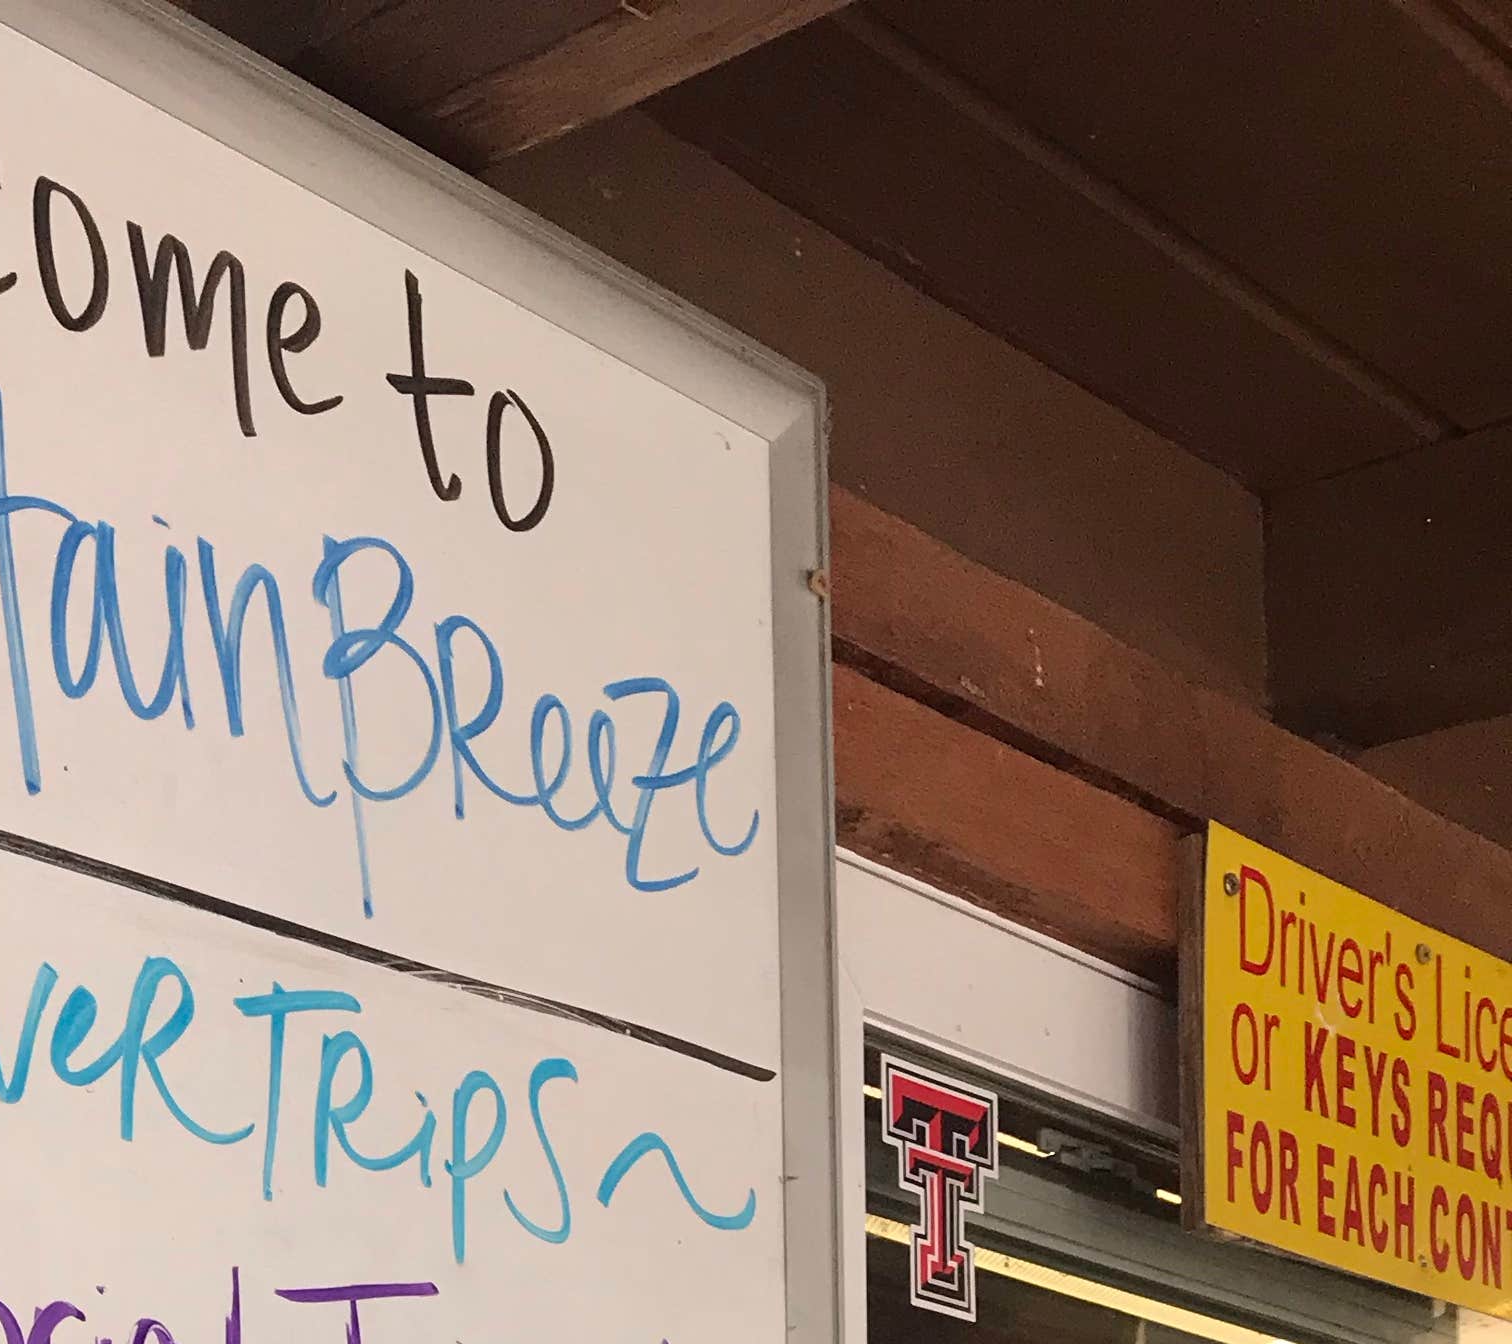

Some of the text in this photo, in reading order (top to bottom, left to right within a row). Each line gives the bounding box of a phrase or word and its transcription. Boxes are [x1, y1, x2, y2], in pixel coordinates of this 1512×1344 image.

[387, 268, 555, 532] to
[1239, 865, 1416, 1041] Driver's
[1231, 1003, 1512, 1188] or KEYS REQ
[1226, 1109, 1301, 1224] FOR
[1316, 1146, 1416, 1263] EACH
